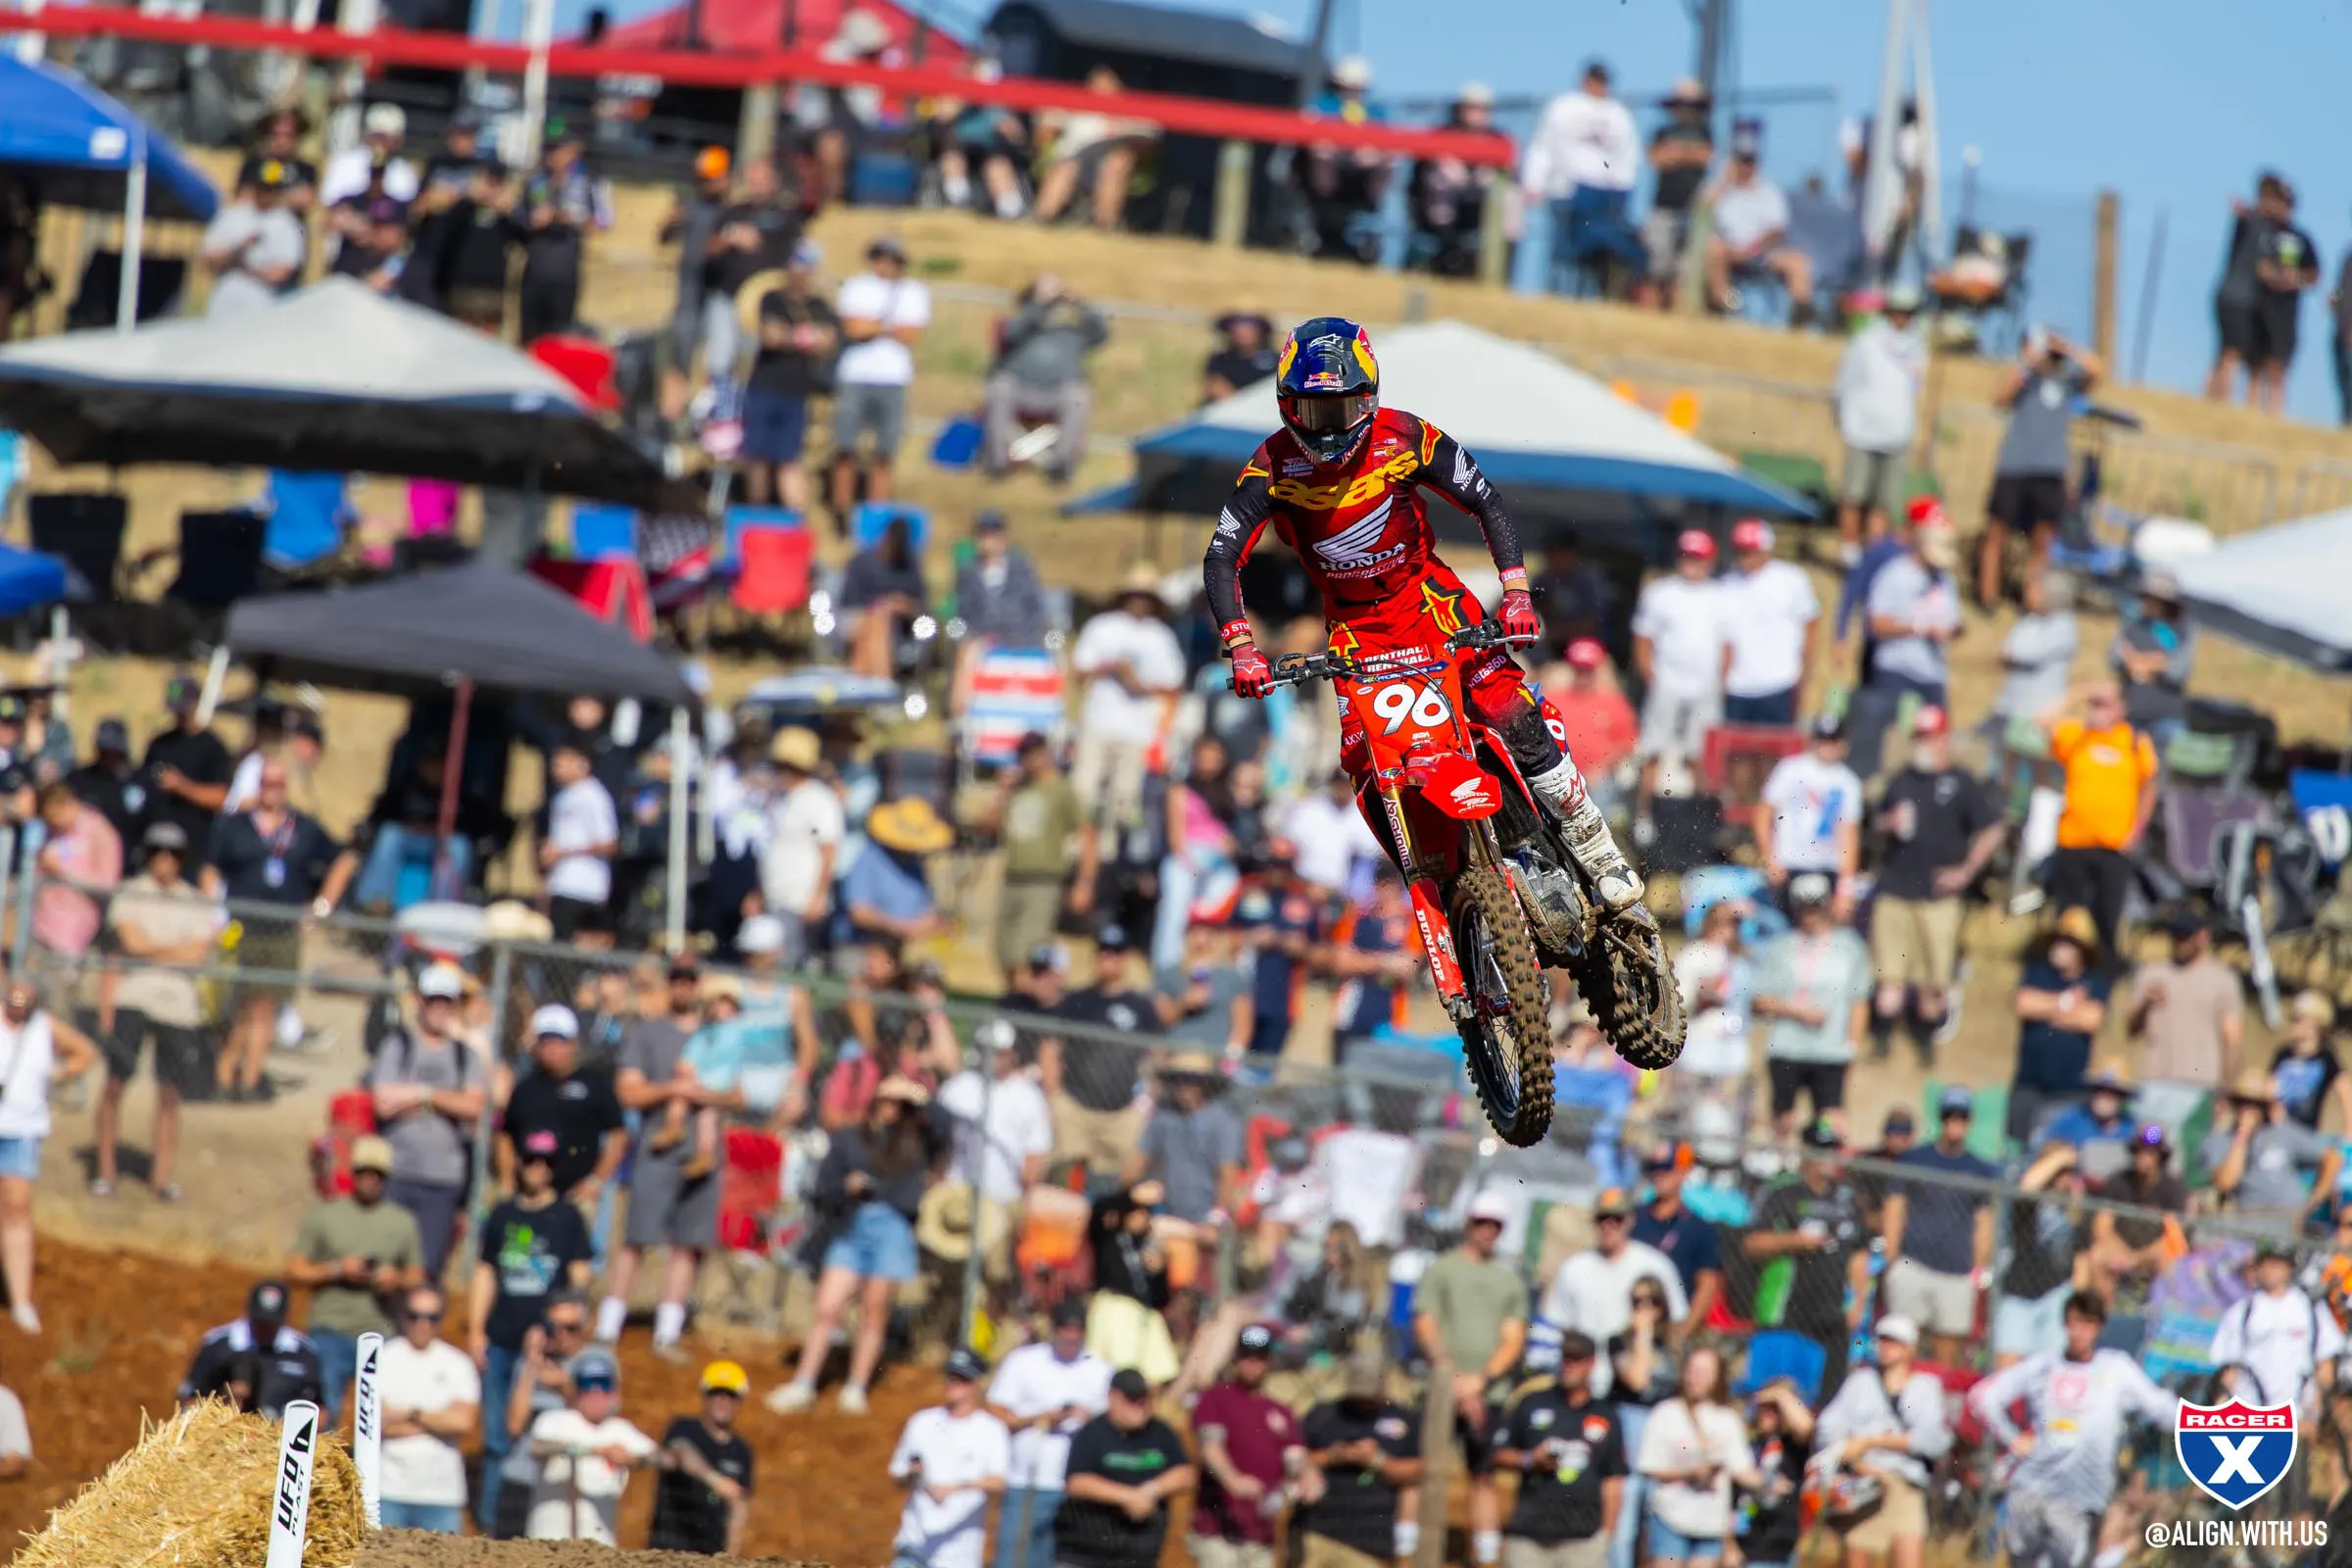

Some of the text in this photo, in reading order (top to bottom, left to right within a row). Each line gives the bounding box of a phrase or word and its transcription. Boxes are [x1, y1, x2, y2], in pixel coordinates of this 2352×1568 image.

[1318, 542, 1407, 570] HONDA
[1326, 553, 1405, 579] PROGRESSIVE
[1364, 646, 1423, 663] RENTHAL
[1373, 678, 1450, 737] 96
[1416, 909, 1446, 981] DUNLOP
[359, 1377, 369, 1436] UFO
[277, 1452, 300, 1532] UFO
[291, 1465, 306, 1537] PLAST
